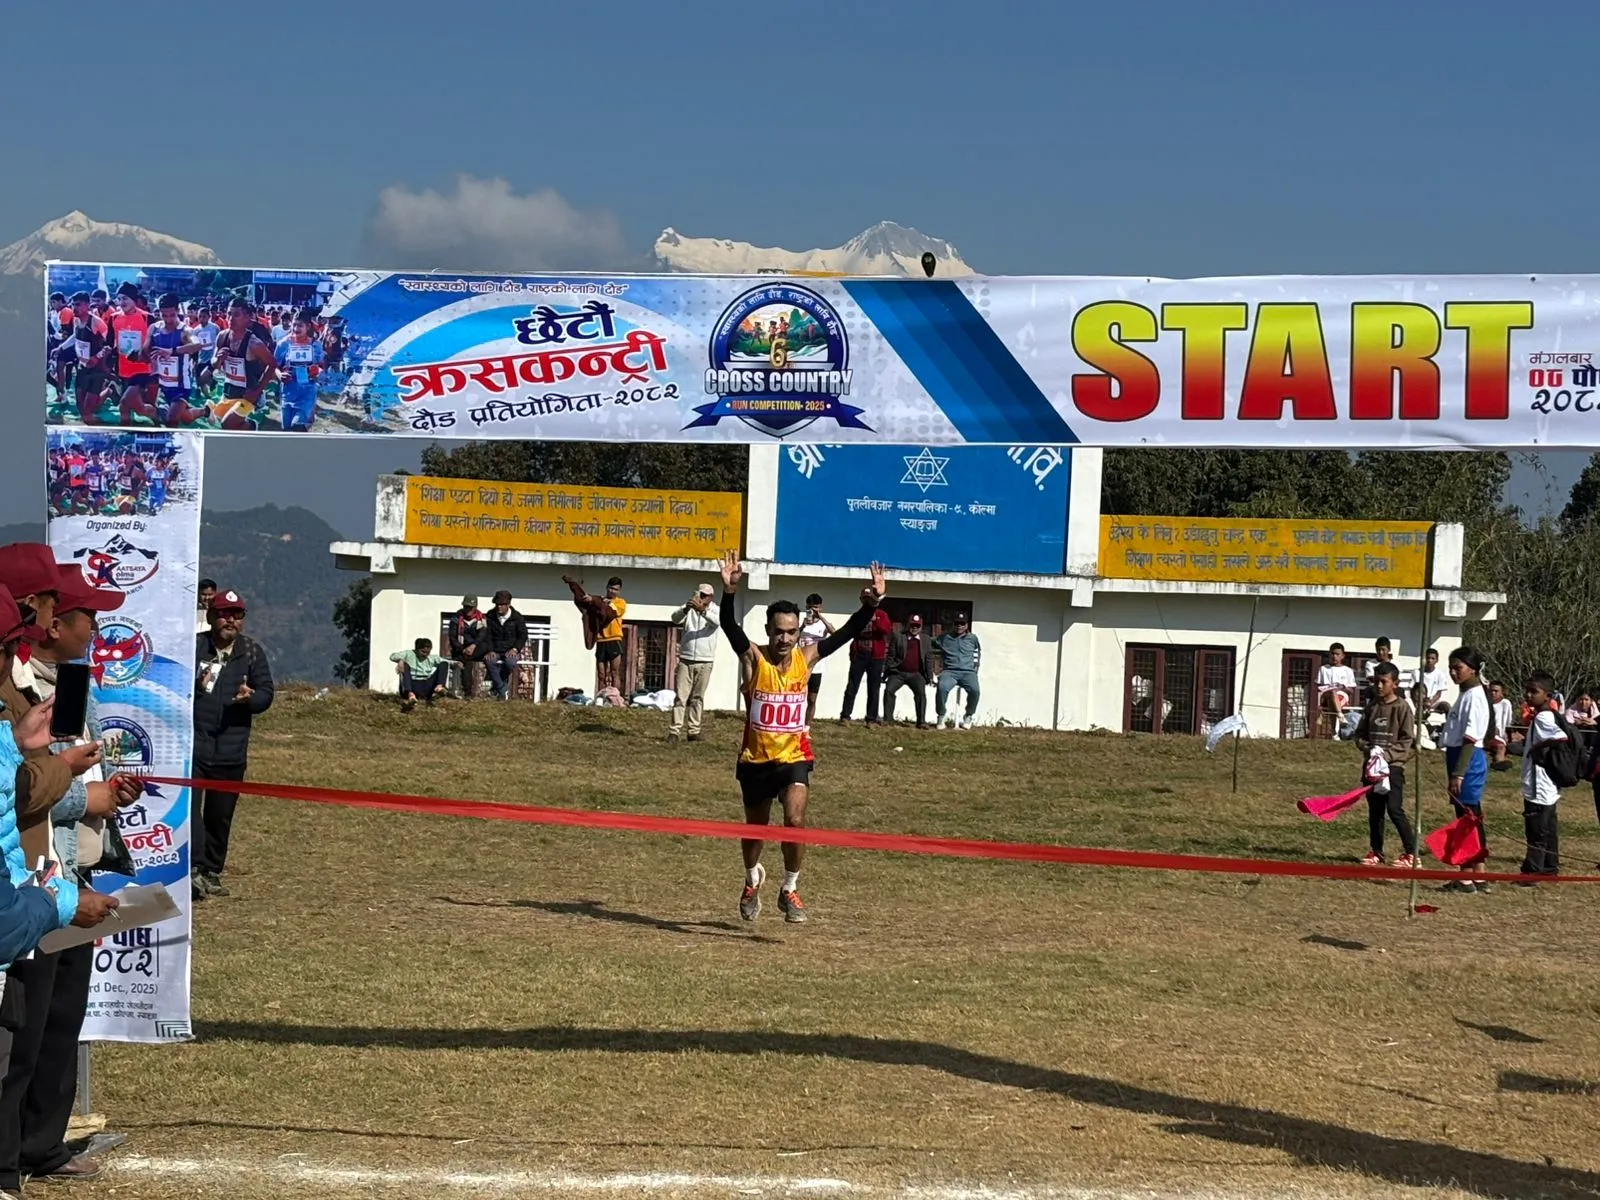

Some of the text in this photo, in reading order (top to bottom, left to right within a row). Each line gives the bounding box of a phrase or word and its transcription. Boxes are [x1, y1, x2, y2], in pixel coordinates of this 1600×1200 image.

[469, 280, 500, 293] लागि
[527, 281, 567, 295] राष्ट्रको
[571, 282, 600, 295] लागि
[771, 339, 788, 368] 6
[1071, 301, 1534, 422] START
[1529, 351, 1594, 364] मंगलबार
[393, 331, 667, 402] क्रसकन्ट्री
[1572, 364, 1600, 387] पौ
[705, 369, 853, 395] CROSS COUNTRY
[732, 401, 748, 410] RUN
[805, 401, 825, 411] 2025
[1530, 389, 1600, 415] २०८
[409, 408, 456, 431] दौड
[517, 489, 543, 507] जसले
[969, 501, 996, 515] कोल्मा
[86, 520, 147, 533] Organized By:
[444, 511, 470, 529] यस्तो
[760, 703, 801, 725] 004
[123, 823, 173, 853] न्ट्री
[95, 949, 153, 977] ०८२
[88, 982, 100, 993] rd
[130, 983, 158, 995] 2025)
